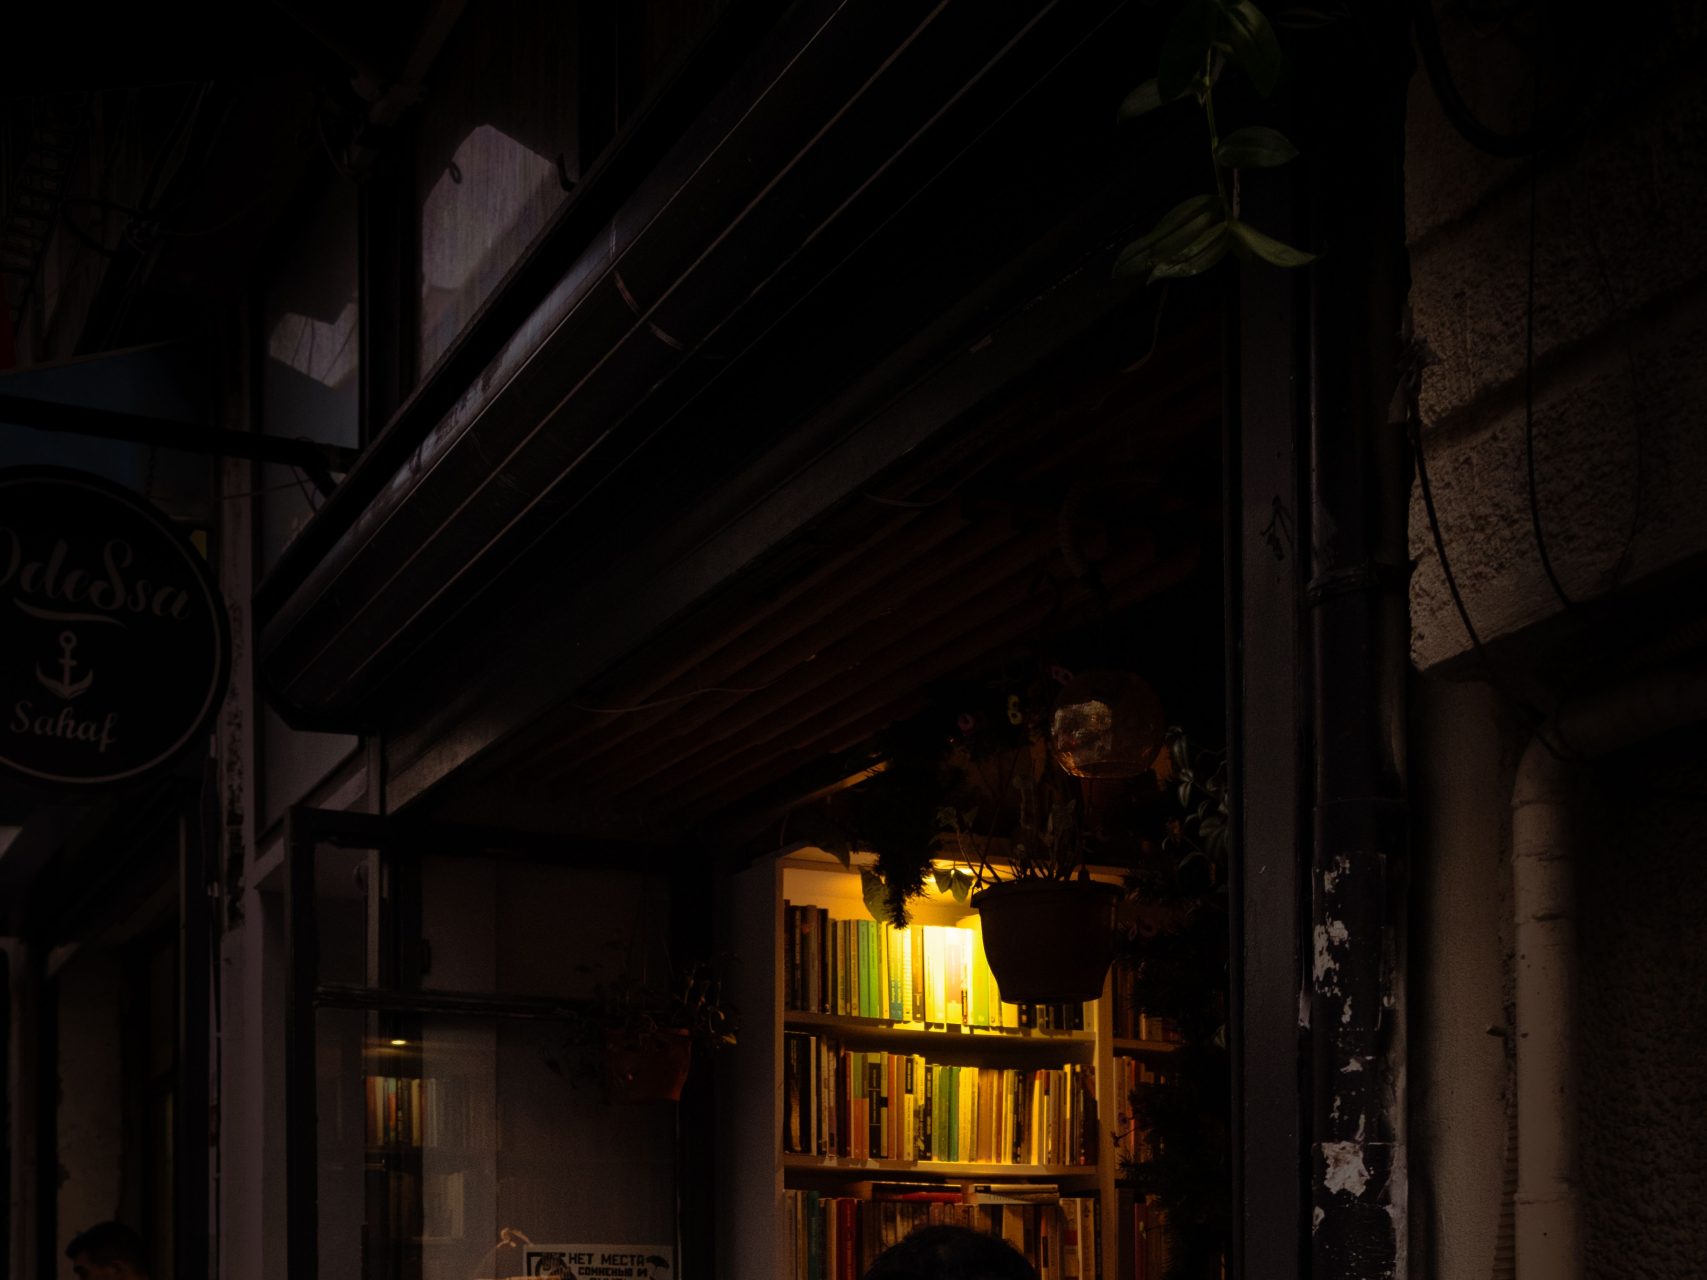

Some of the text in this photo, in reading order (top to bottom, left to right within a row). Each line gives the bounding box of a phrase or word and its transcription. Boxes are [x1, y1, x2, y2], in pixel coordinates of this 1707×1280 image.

[10, 699, 119, 753] Sahaf
[568, 1252, 646, 1266] НЕТ МЕСТА
[637, 1267, 648, 1277] И
